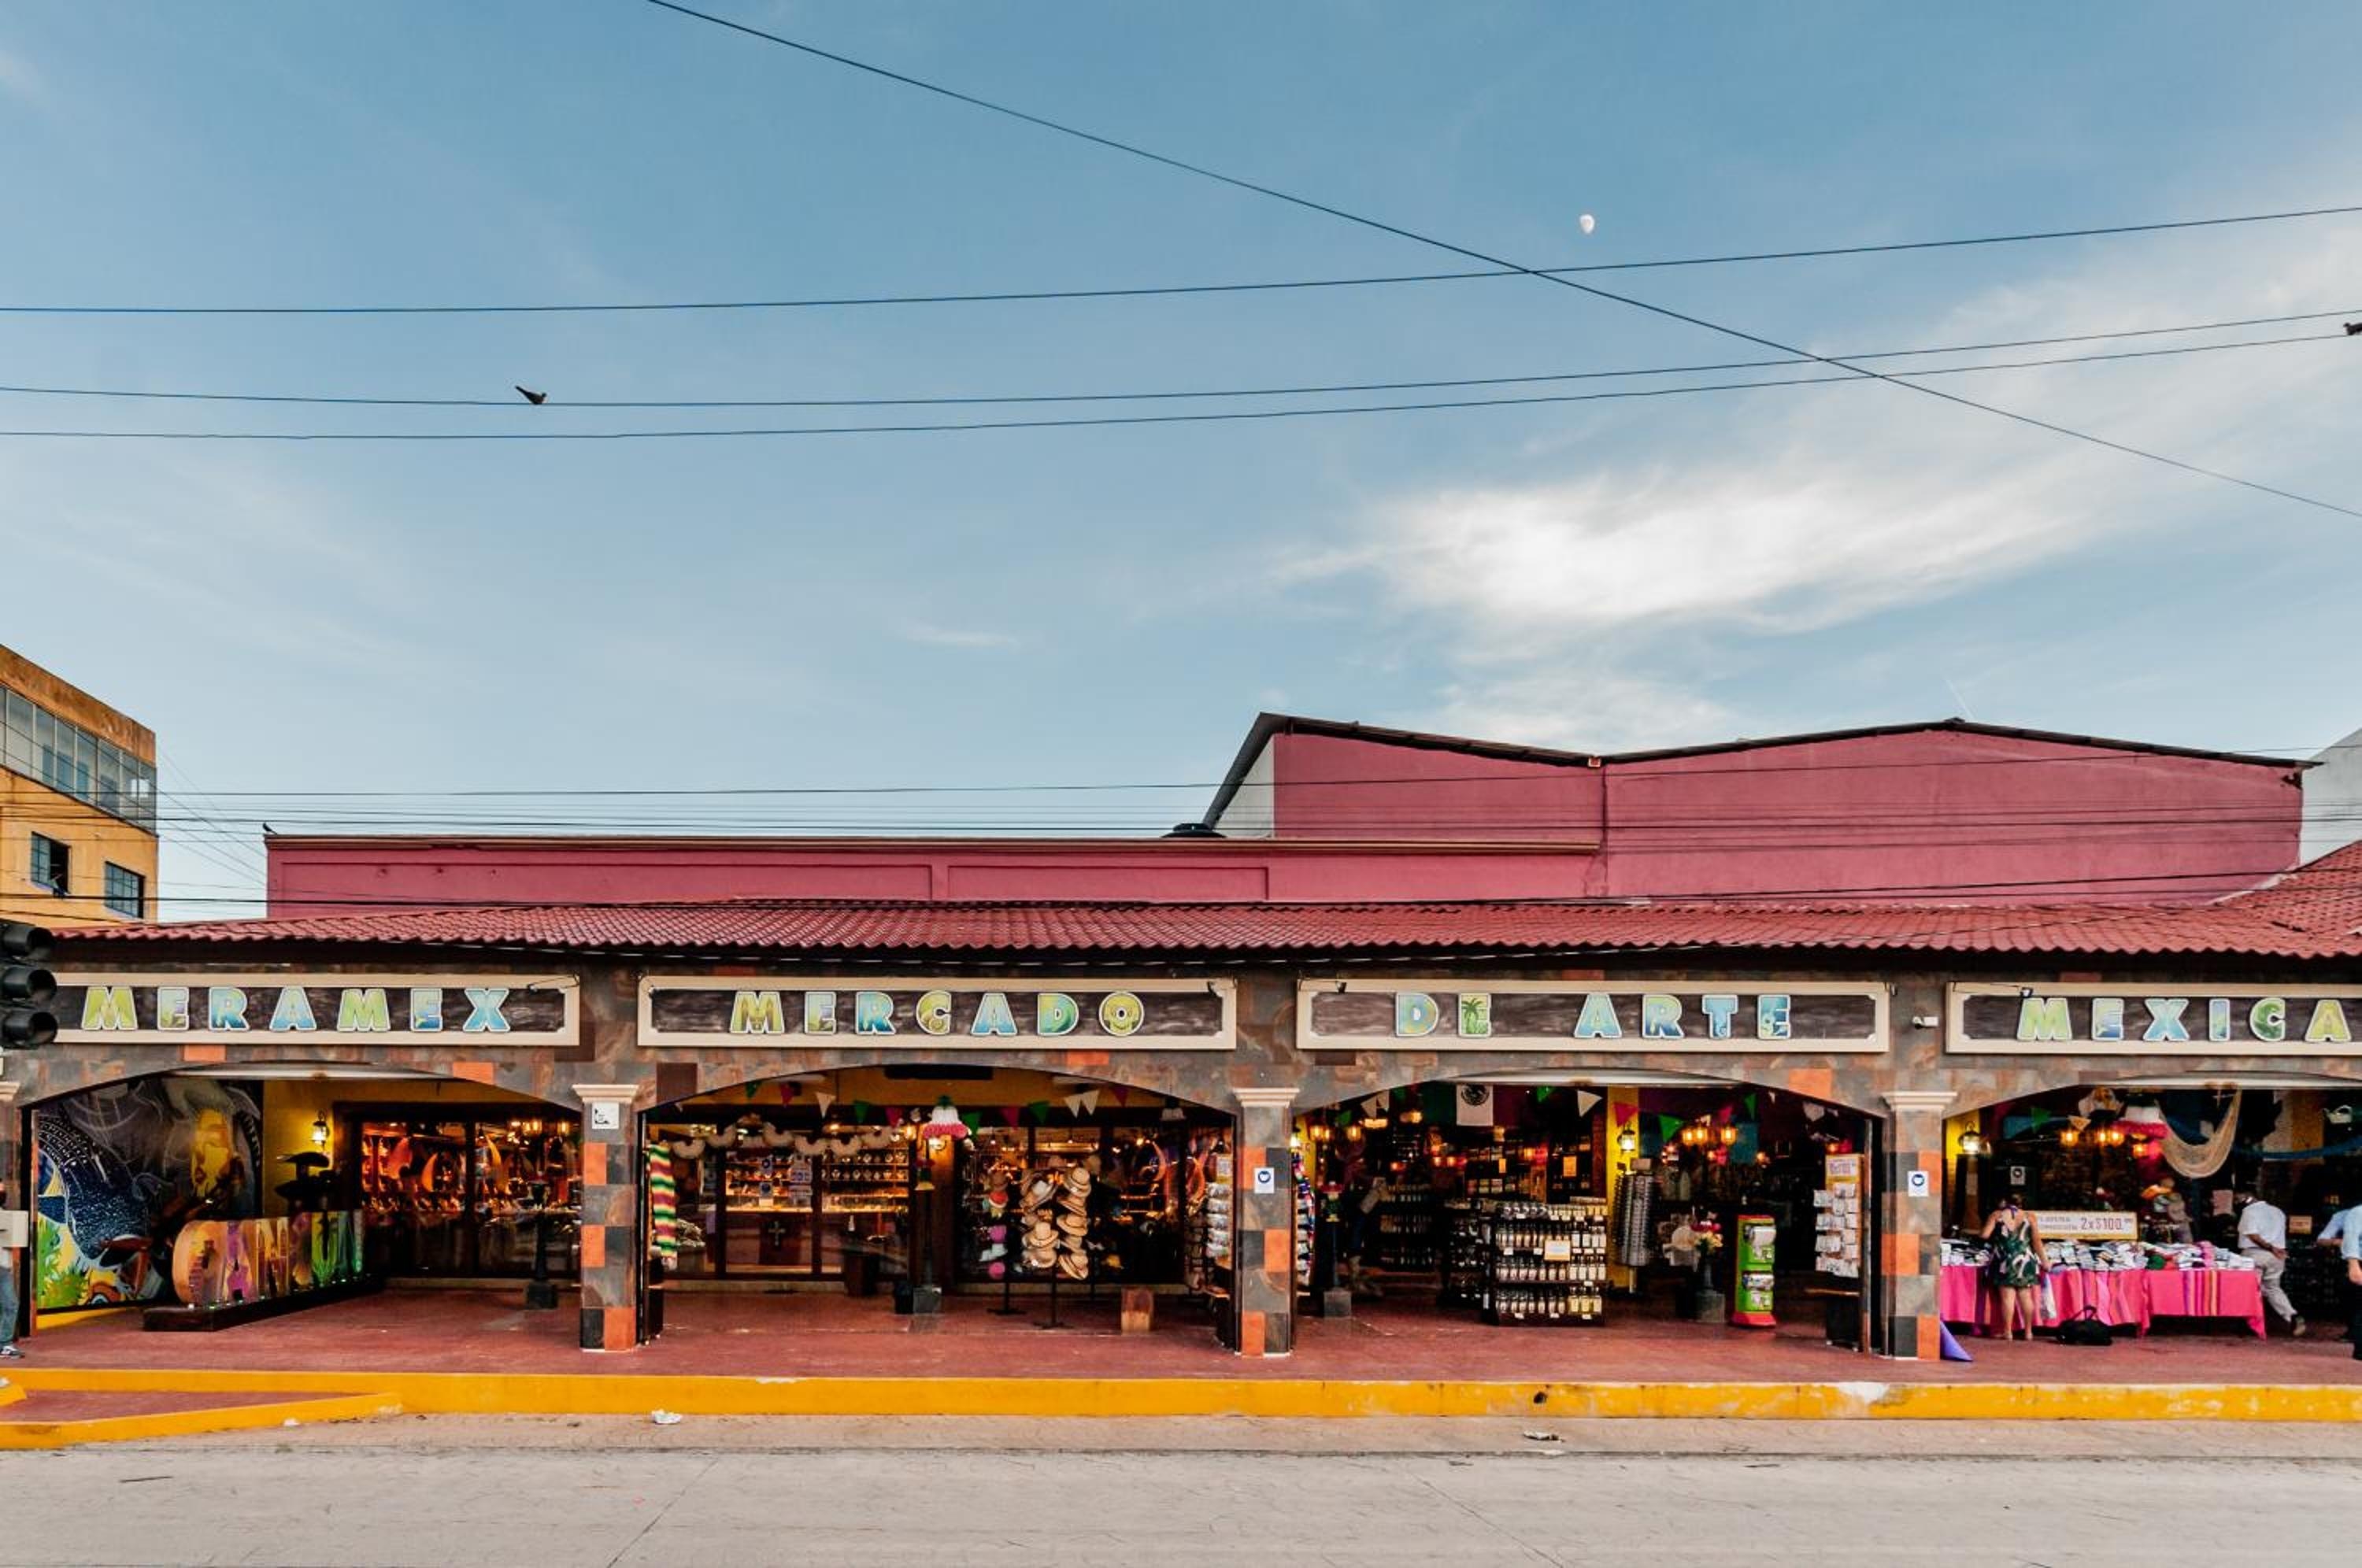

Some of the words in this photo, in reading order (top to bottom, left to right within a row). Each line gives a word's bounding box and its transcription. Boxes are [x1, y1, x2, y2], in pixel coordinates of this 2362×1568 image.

[81, 986, 511, 1032] MERAMEX
[729, 990, 1146, 1036] MERCADO
[1394, 992, 1492, 1037] DE
[1573, 993, 1792, 1039] ARTE
[2016, 997, 2353, 1042] MEXICA
